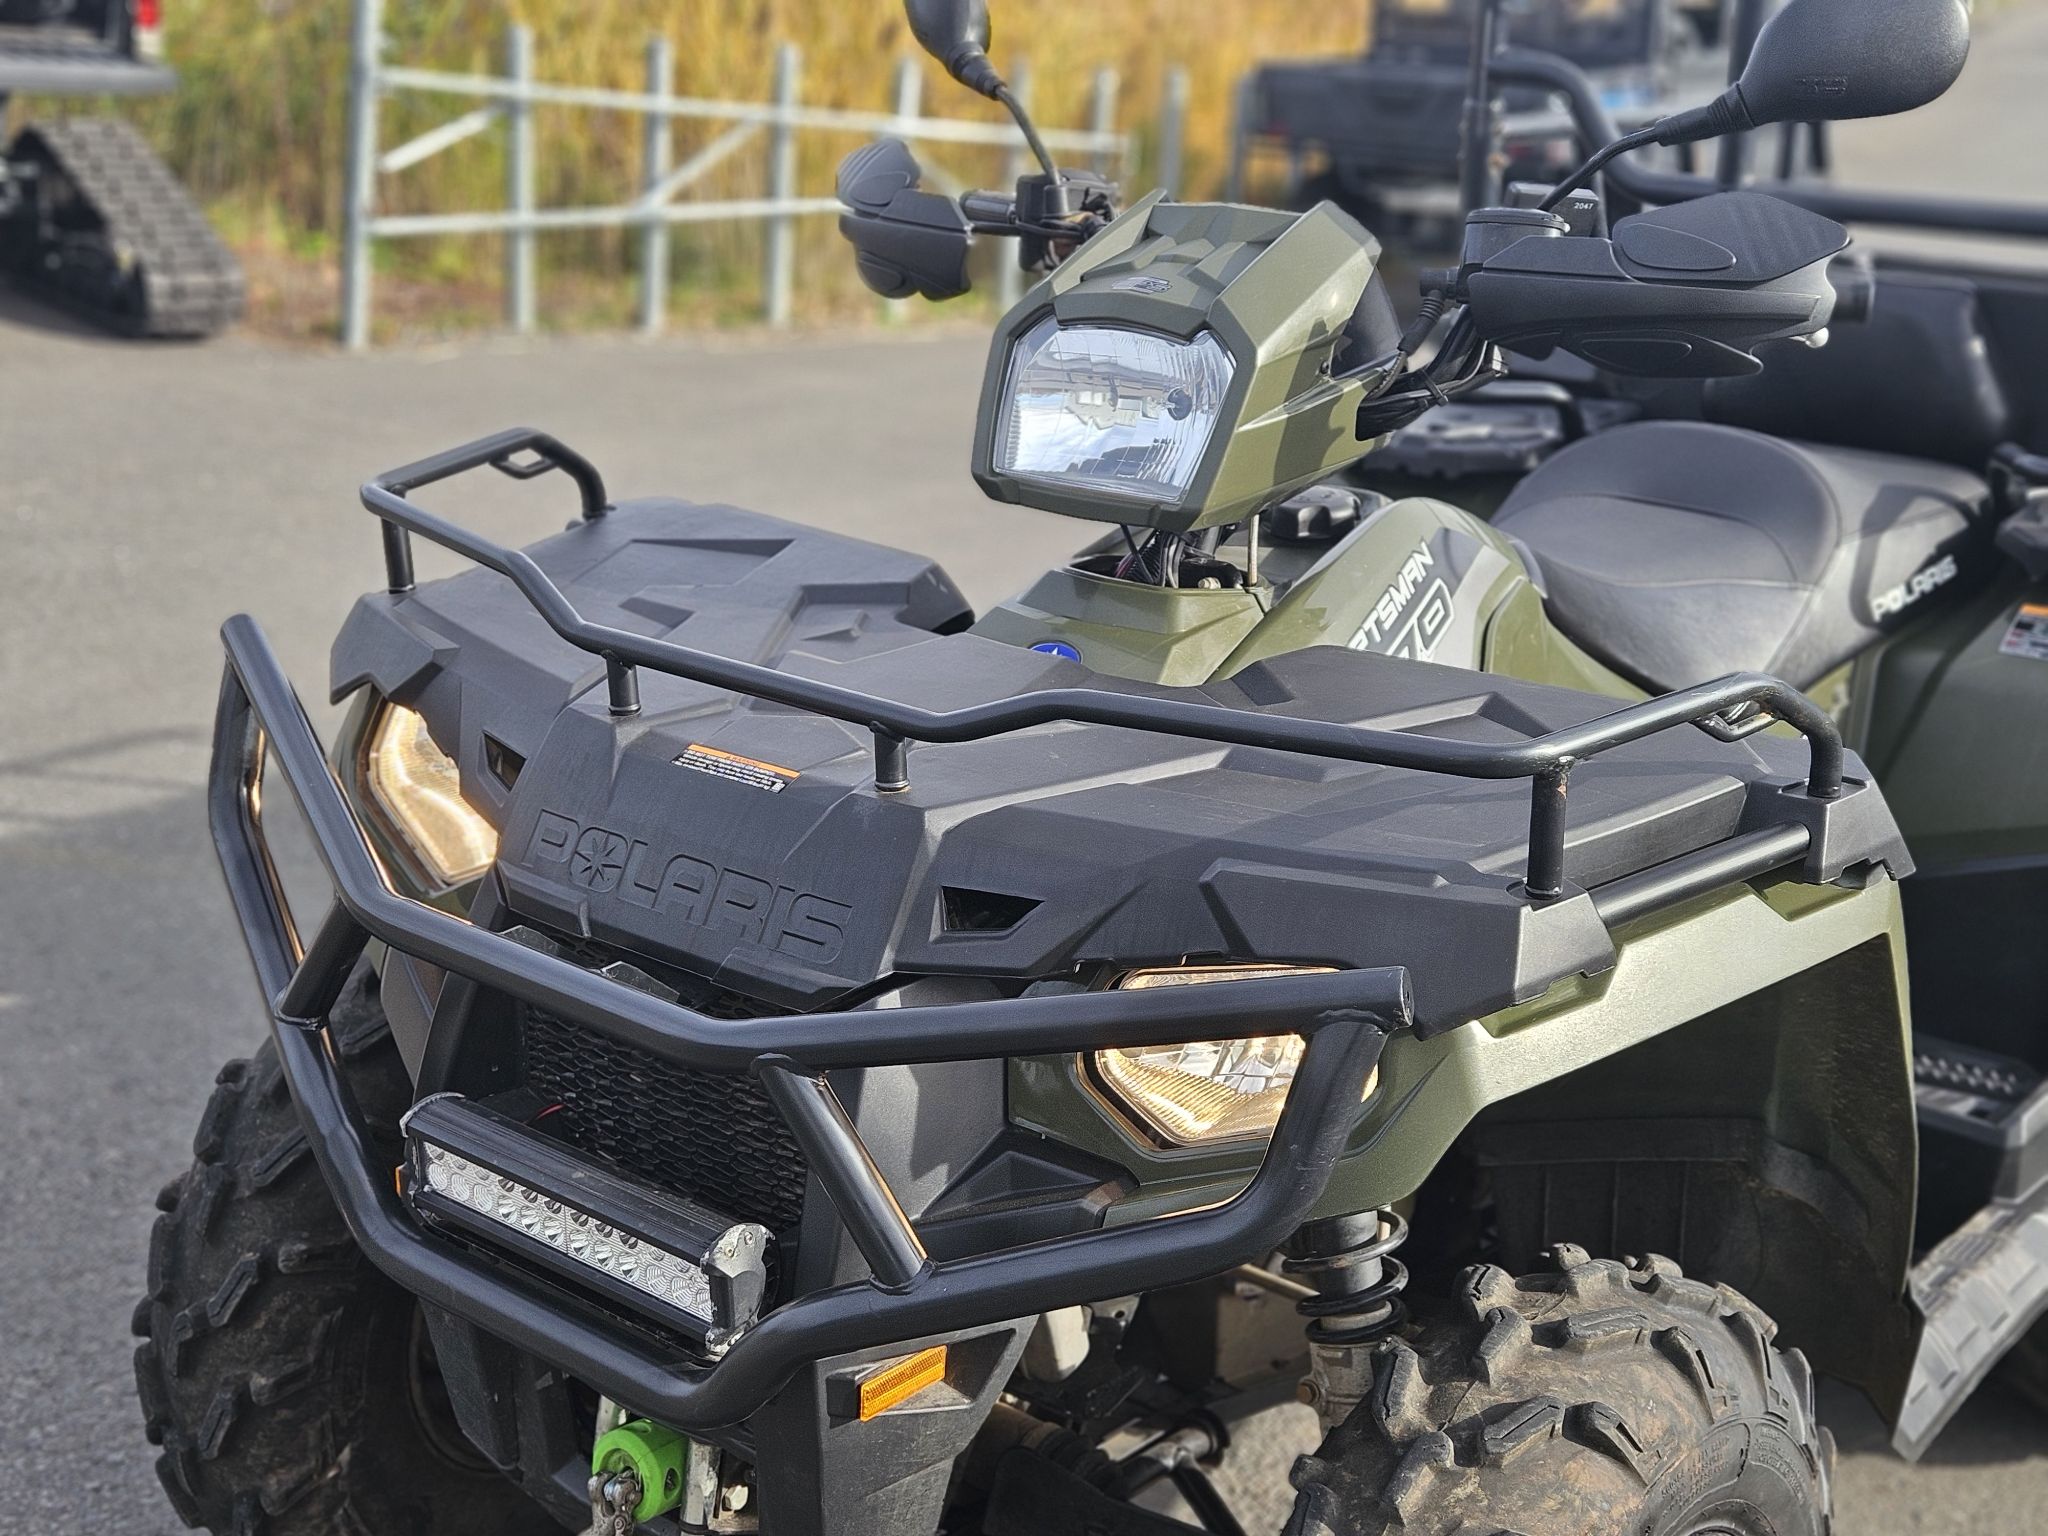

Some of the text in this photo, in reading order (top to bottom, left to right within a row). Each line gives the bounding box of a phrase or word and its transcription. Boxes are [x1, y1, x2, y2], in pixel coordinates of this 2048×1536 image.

[1574, 201, 1594, 211] 2047
[1869, 553, 1959, 622] POLARIS
[520, 807, 853, 964] POLARIS
